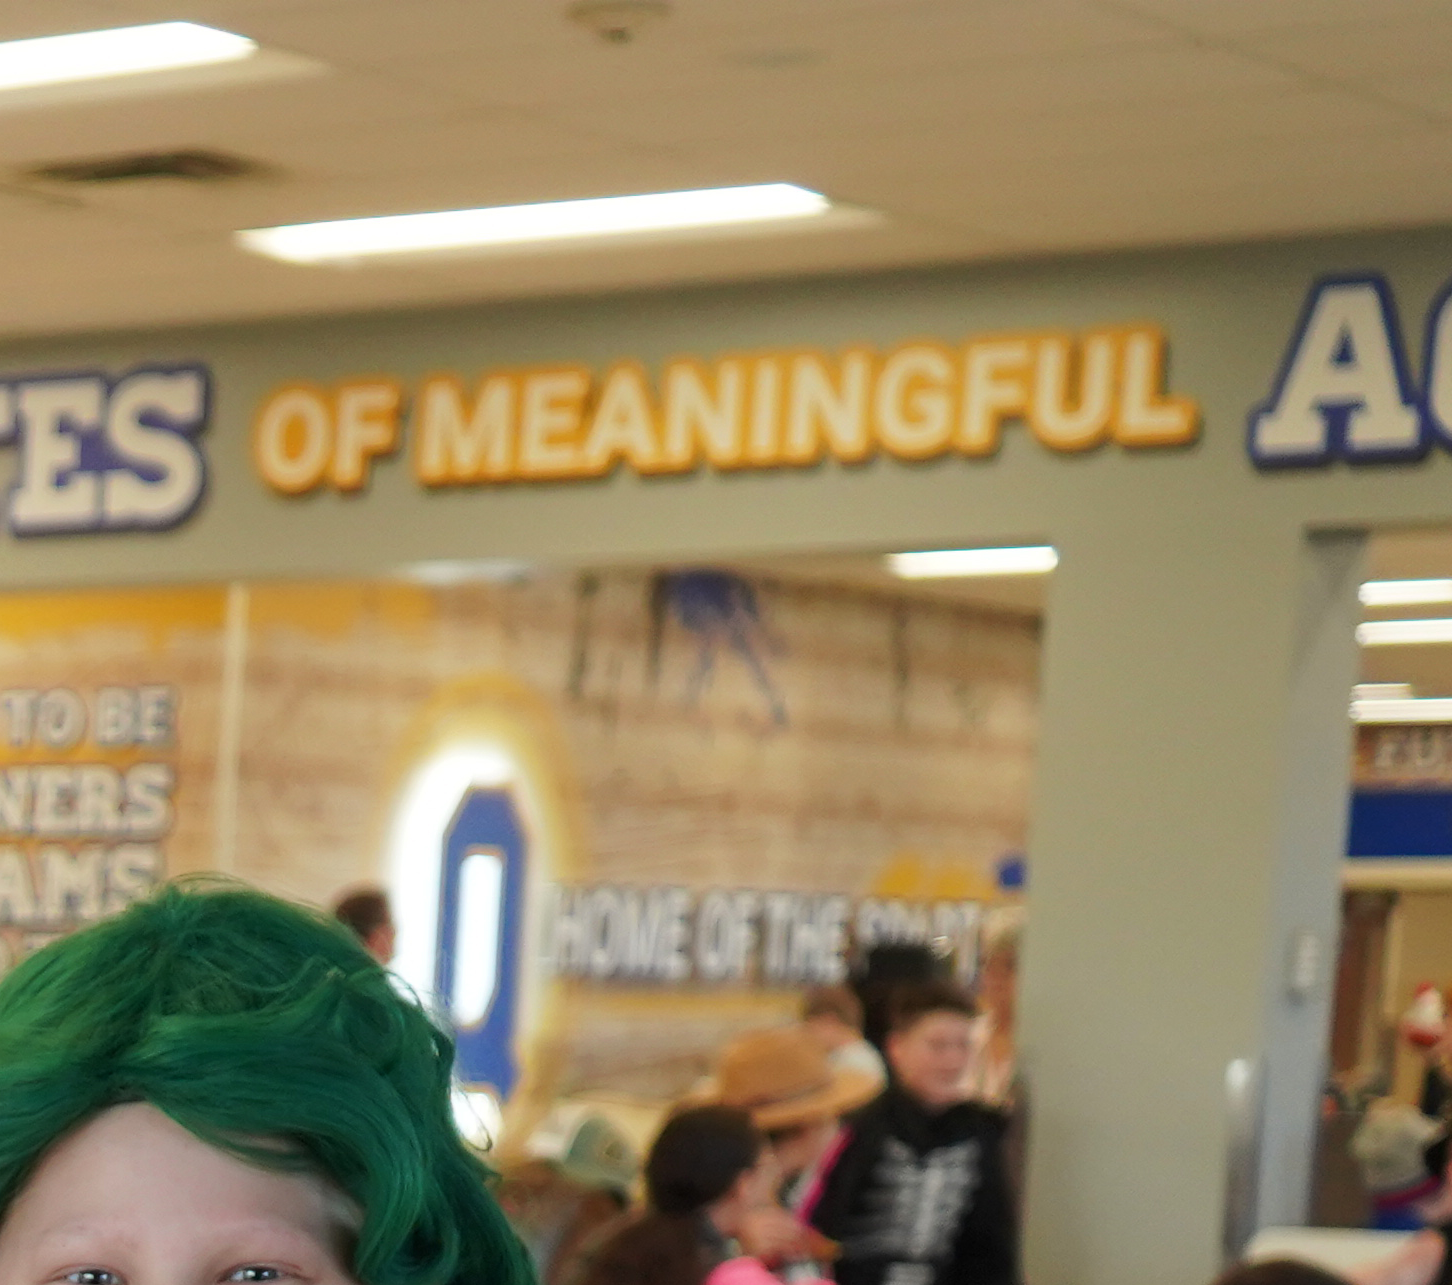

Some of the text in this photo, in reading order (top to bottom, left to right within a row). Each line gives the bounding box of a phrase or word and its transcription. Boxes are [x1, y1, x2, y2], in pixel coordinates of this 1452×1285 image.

[255, 323, 1200, 495] OF MEANINGFUL
[1247, 272, 1452, 473] A
[0, 687, 87, 748] TO
[94, 684, 176, 749] BE
[547, 884, 692, 981] HOME
[696, 889, 759, 982] OF
[761, 890, 850, 986] THE
